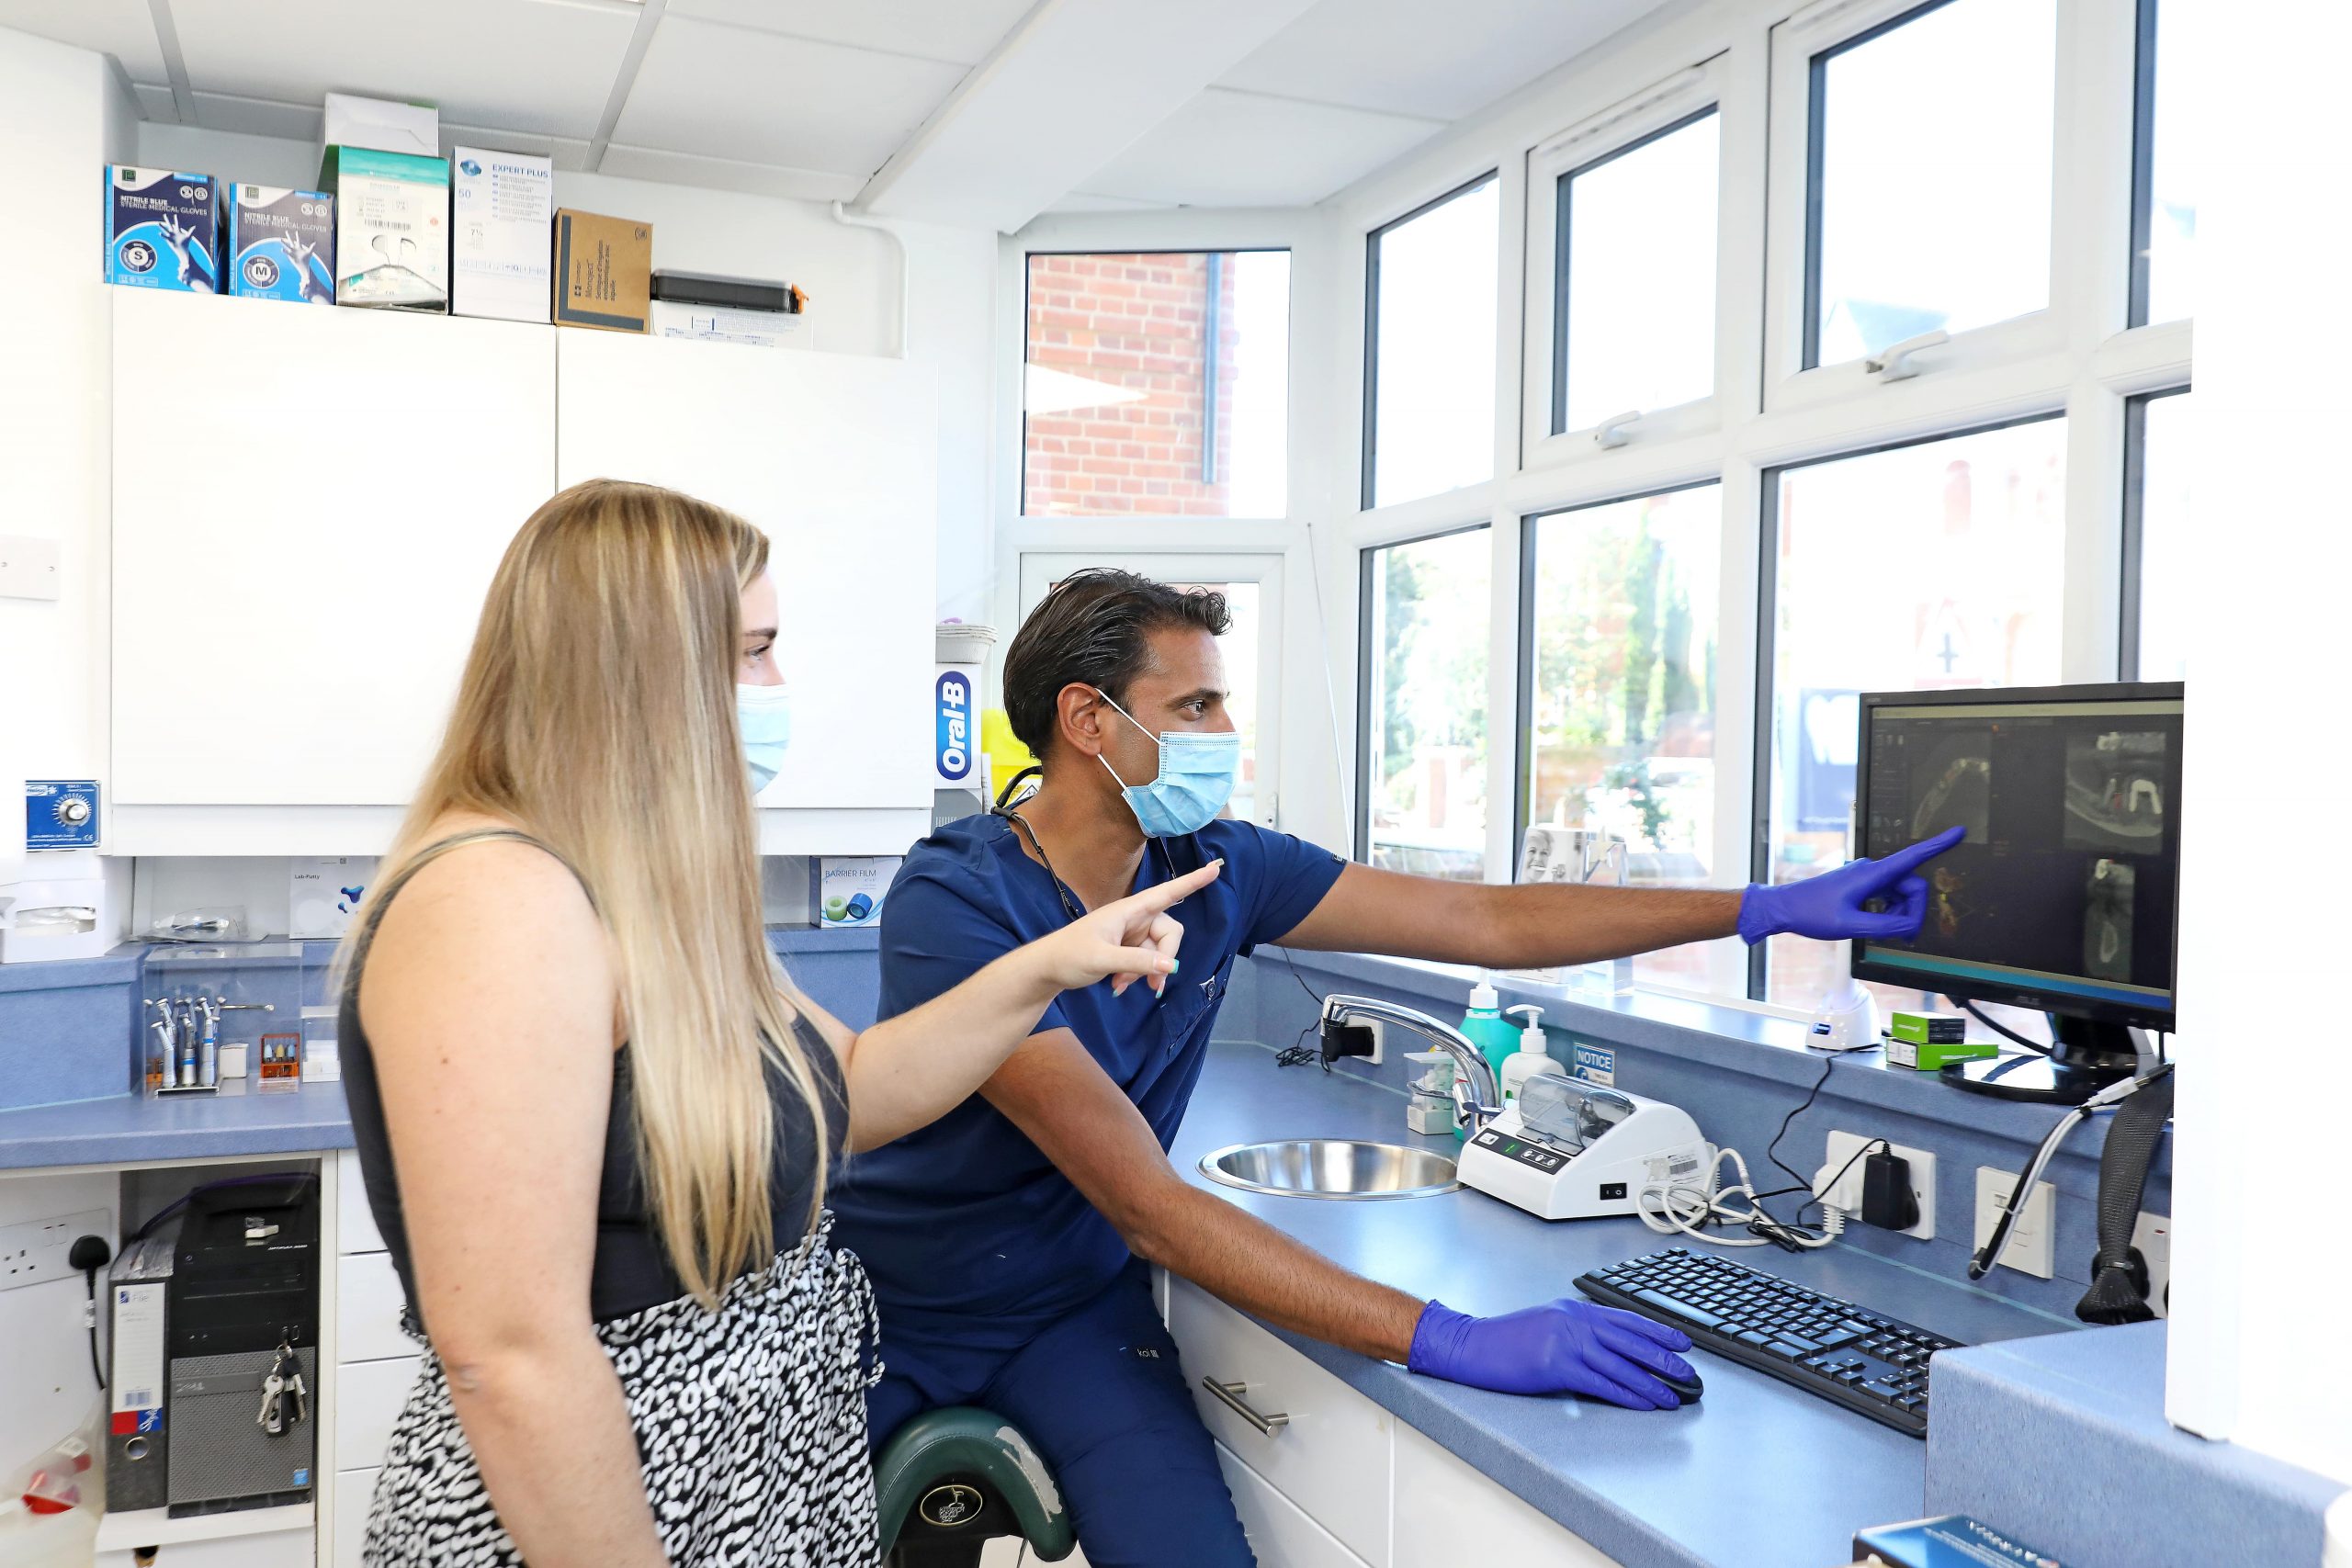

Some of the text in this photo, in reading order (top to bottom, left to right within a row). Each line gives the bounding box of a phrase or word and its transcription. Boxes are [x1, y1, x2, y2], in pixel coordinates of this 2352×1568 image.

[492, 164, 548, 178] EXPERT PLUS
[120, 195, 168, 206] NITRILE BLUE
[120, 202, 208, 216] STERILE MEDICAL GLOVES
[244, 211, 271, 220] NITRILE
[301, 223, 327, 233] GLOVES
[134, 251, 142, 260] S
[255, 266, 267, 276] M
[942, 681, 967, 773] Oral-B
[825, 869, 876, 877] BARRIER FILM
[1577, 1049, 1612, 1070] NOTICE
